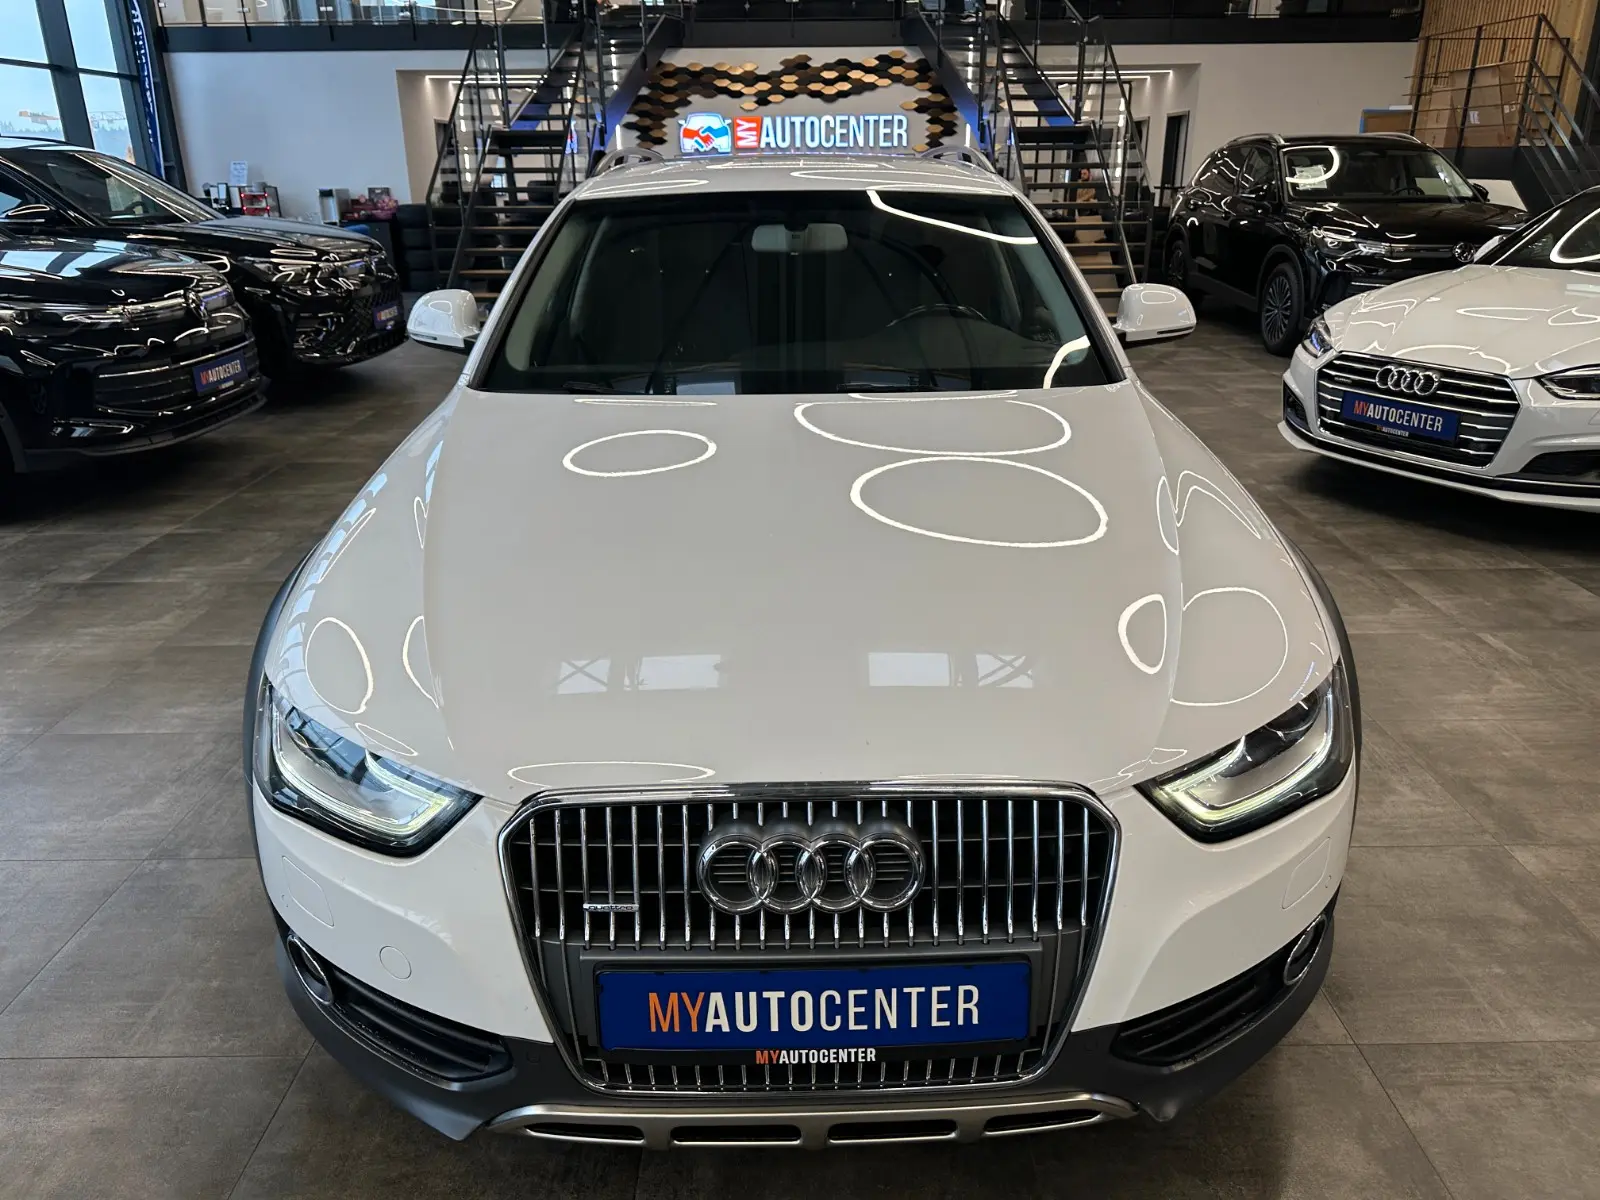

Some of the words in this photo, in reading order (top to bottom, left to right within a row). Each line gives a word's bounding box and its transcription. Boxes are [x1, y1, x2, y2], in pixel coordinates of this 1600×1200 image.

[735, 118, 757, 146] MY
[760, 115, 908, 148] AUTOCENTER
[1353, 400, 1443, 432] MYAUTOCENTER
[648, 985, 979, 1033] MYAUTOCENTER
[755, 1047, 876, 1065] MYAUTOCENTER
